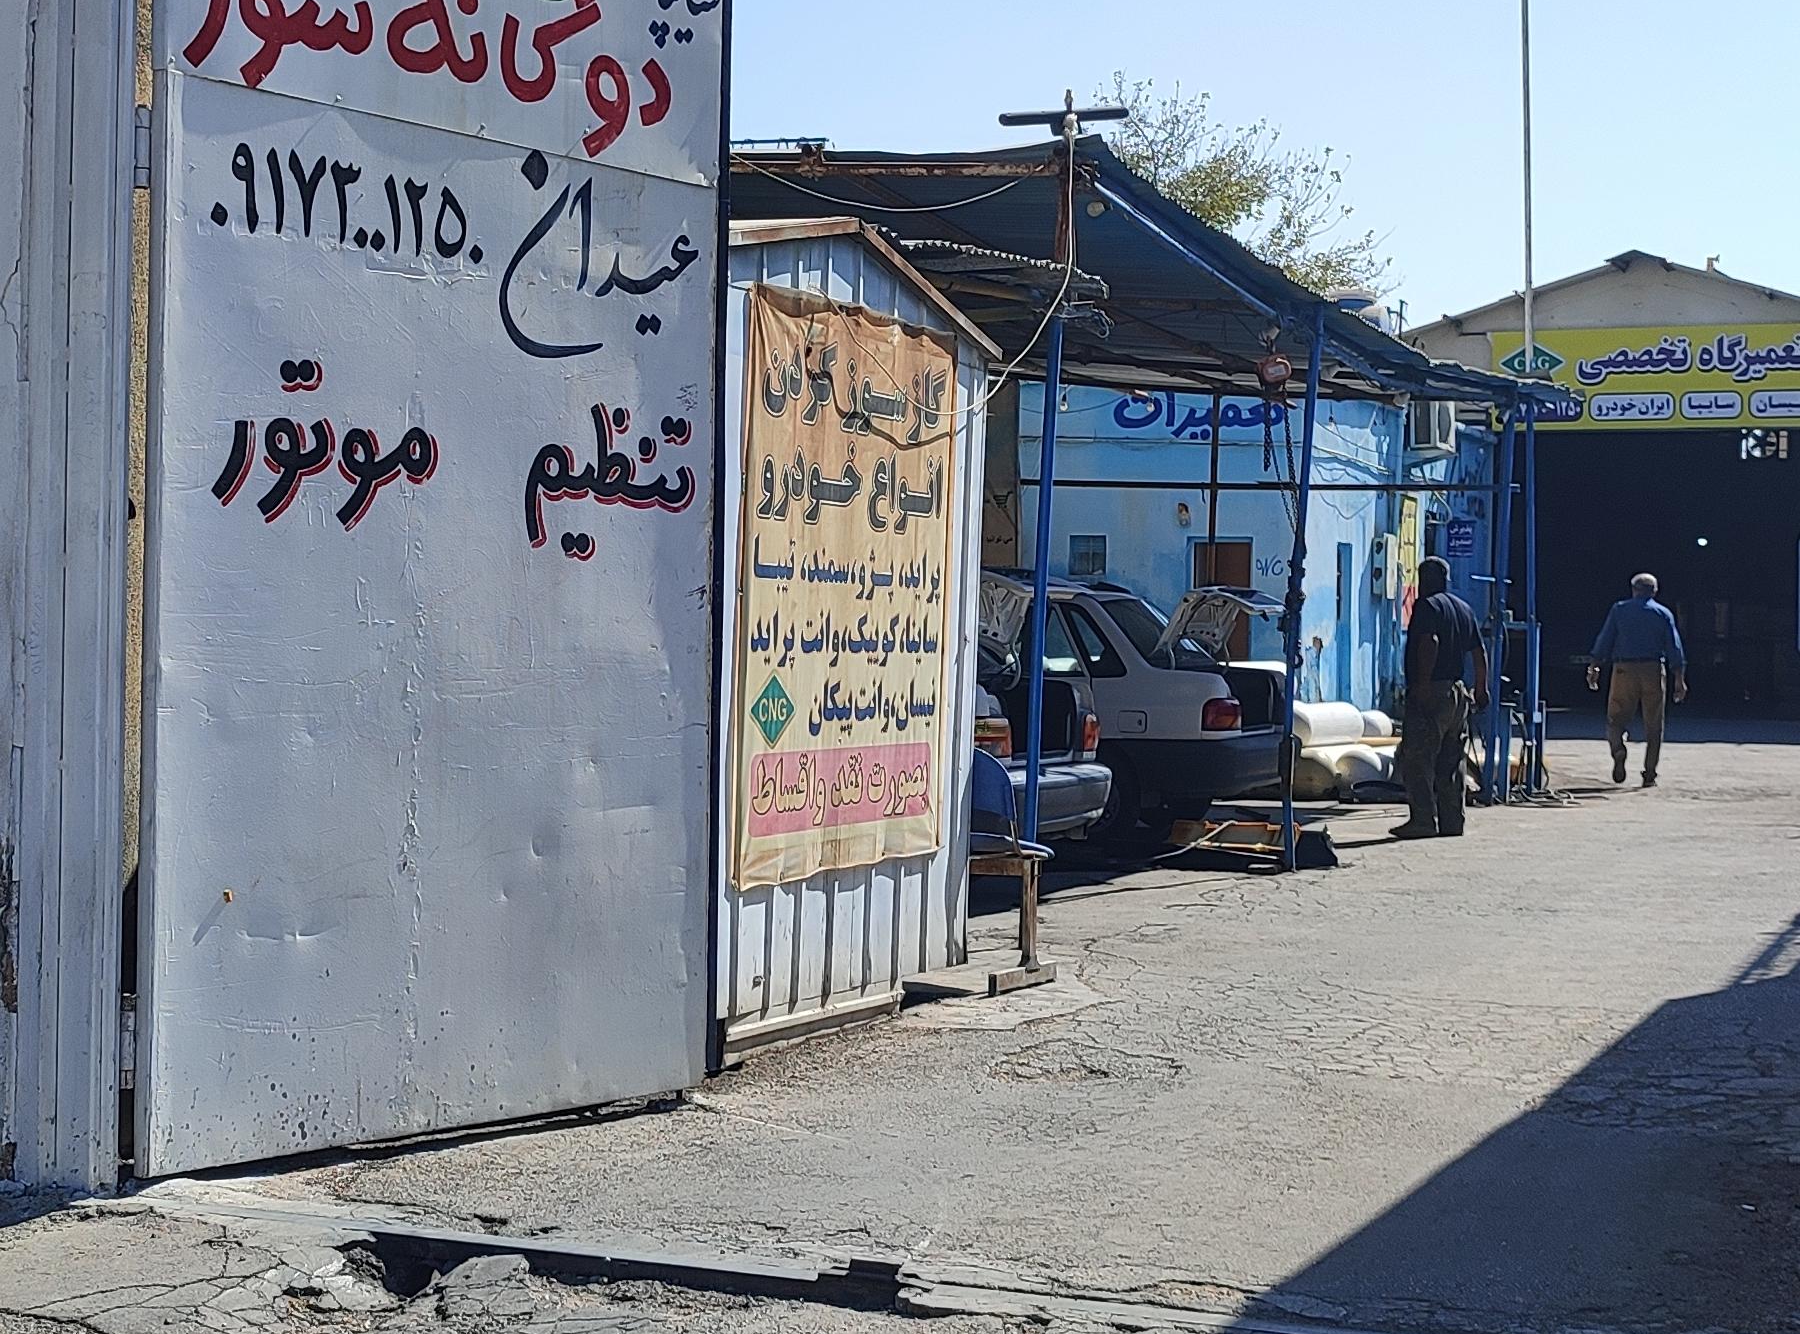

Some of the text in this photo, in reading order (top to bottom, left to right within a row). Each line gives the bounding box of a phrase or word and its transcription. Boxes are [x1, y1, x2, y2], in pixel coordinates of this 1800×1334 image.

[498, 149, 699, 357] عیدان
[763, 341, 839, 426] کردن
[1513, 355, 1551, 371] CG
[1577, 336, 1691, 384] تخصصی
[1595, 397, 1671, 417] ایران خودرو
[1687, 395, 1736, 416] سایپا
[1755, 395, 1800, 414] یسان
[210, 359, 696, 561] تنظیم موتور
[756, 441, 943, 534] انواع خودرو
[750, 607, 796, 670] پراید
[758, 697, 787, 719] CNG
[830, 752, 864, 809] نقد
[866, 761, 929, 817] بصورت
